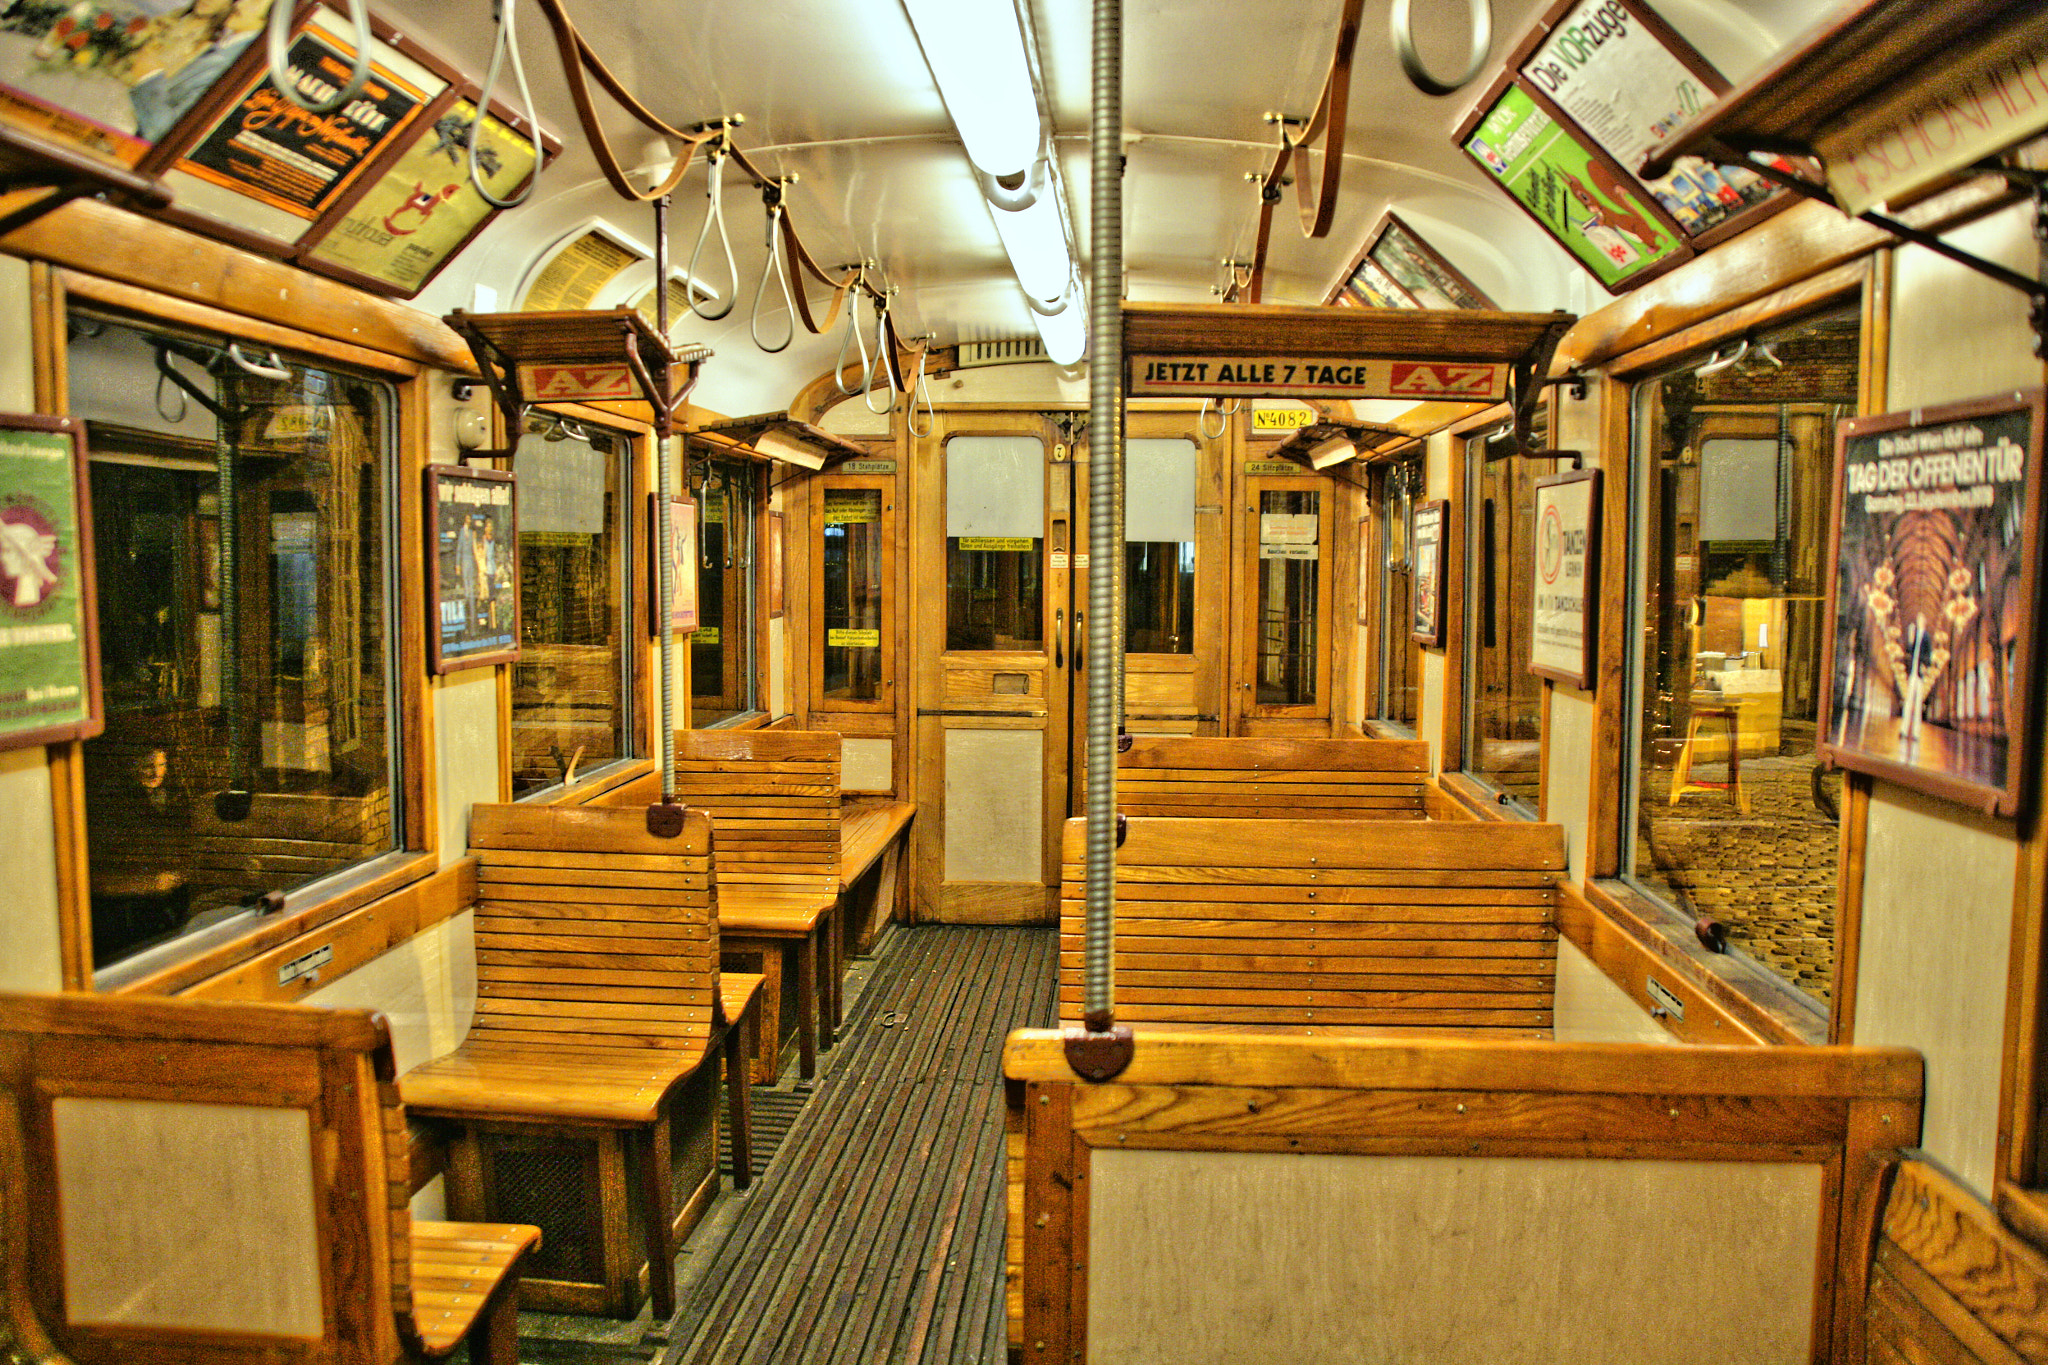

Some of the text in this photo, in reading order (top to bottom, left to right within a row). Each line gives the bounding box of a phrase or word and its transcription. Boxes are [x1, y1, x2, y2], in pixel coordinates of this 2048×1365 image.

[1550, 0, 1628, 71] VORzüge
[1532, 61, 1569, 93] Die
[540, 368, 628, 397] AZ
[1145, 363, 1367, 385] JETZT ALLE 7 TAGE
[1402, 365, 1493, 395] AZ
[1270, 411, 1307, 426] 4082
[1849, 435, 2025, 494] TAG DER OFFENEN TÜR
